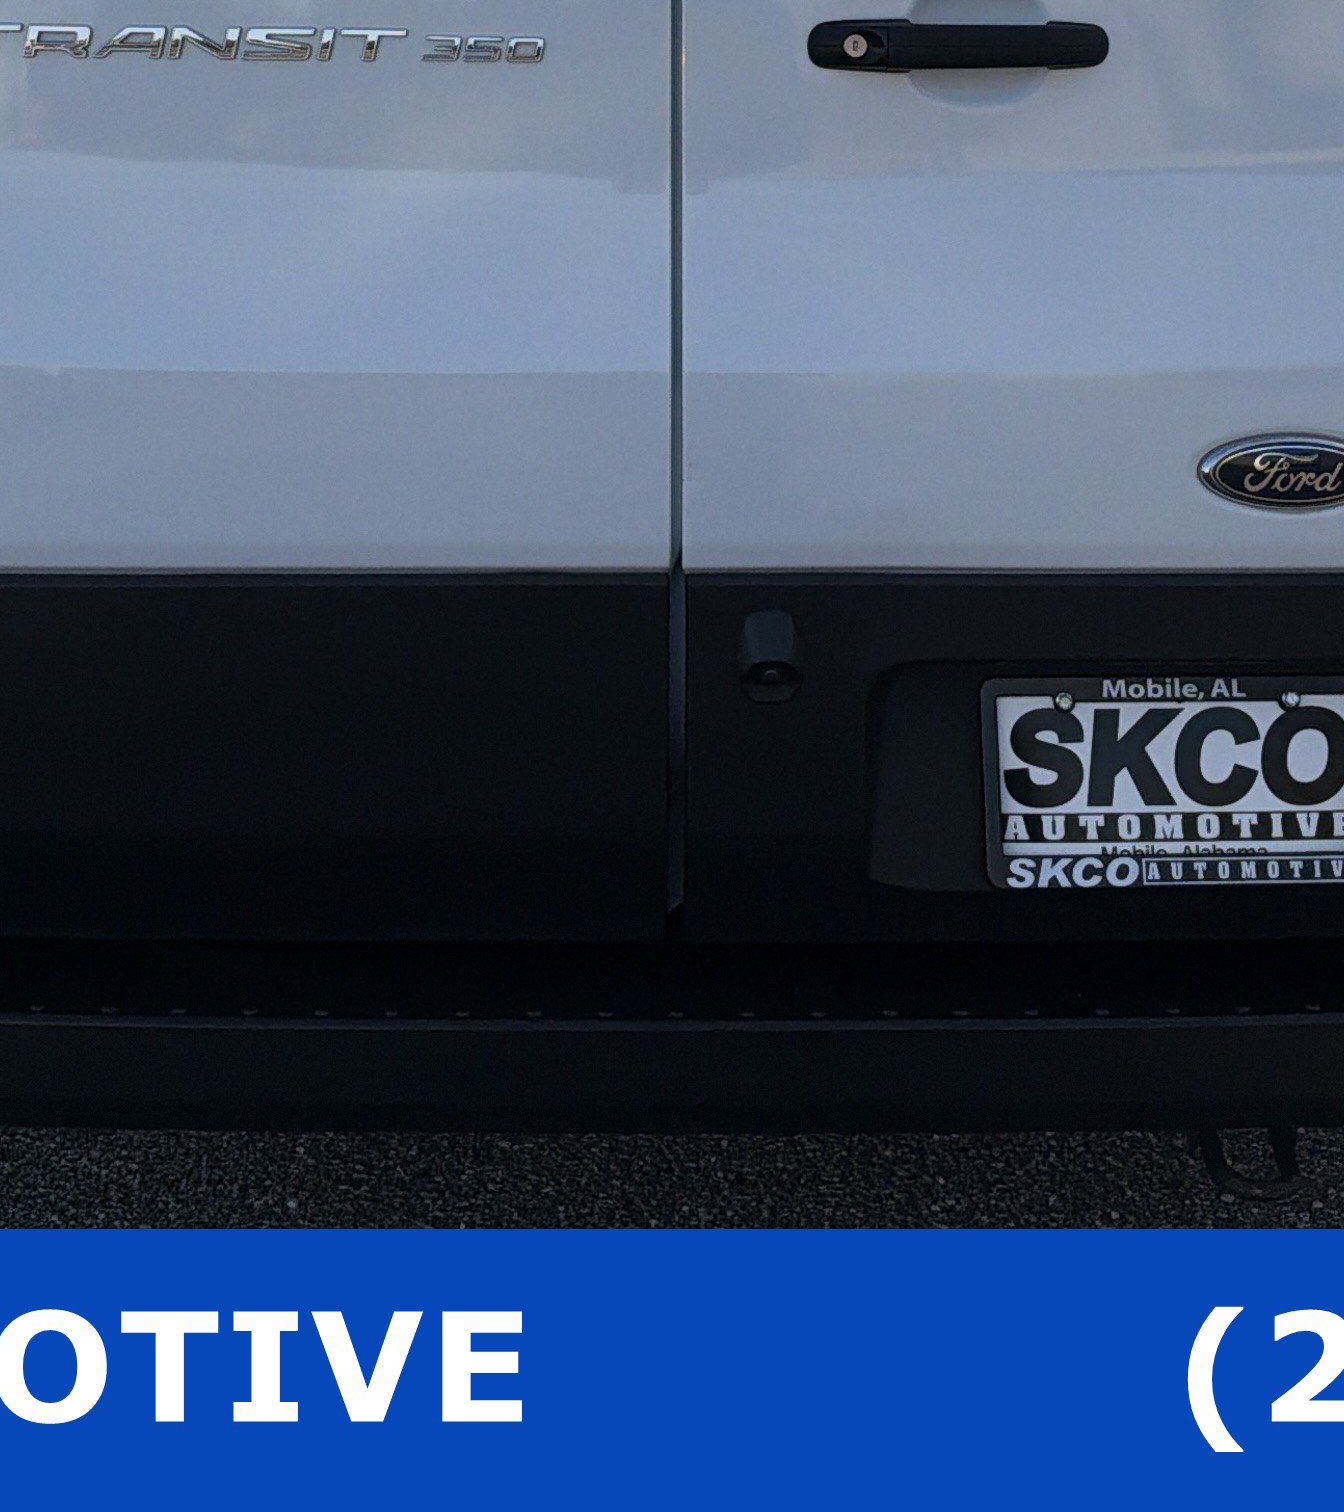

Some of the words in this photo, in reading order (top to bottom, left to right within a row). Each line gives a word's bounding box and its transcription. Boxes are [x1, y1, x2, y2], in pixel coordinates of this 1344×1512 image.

[421, 35, 546, 63] 350
[1244, 452, 1342, 493] Ford
[1102, 678, 1204, 700] Mobile,
[1210, 679, 1247, 698] AL
[1007, 856, 1140, 889] SKCO
